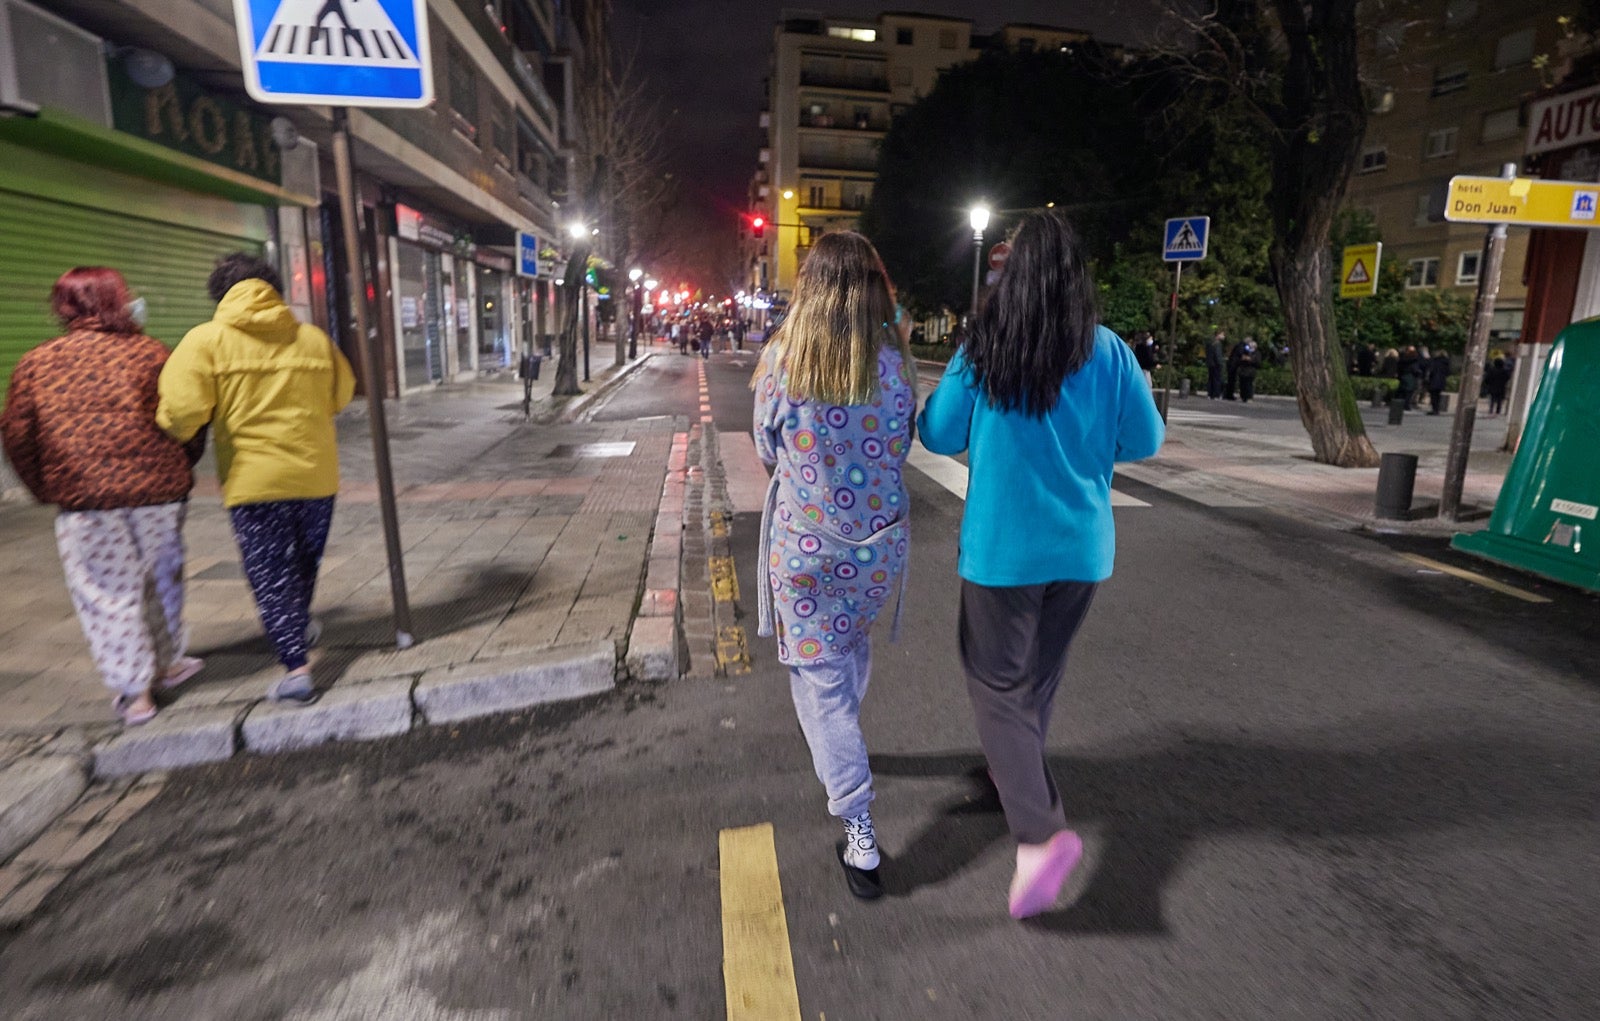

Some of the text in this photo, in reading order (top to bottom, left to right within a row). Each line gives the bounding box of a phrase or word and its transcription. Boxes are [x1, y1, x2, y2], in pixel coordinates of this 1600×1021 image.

[1458, 184, 1483, 193] hotel
[1455, 200, 1517, 215] Don Juan
